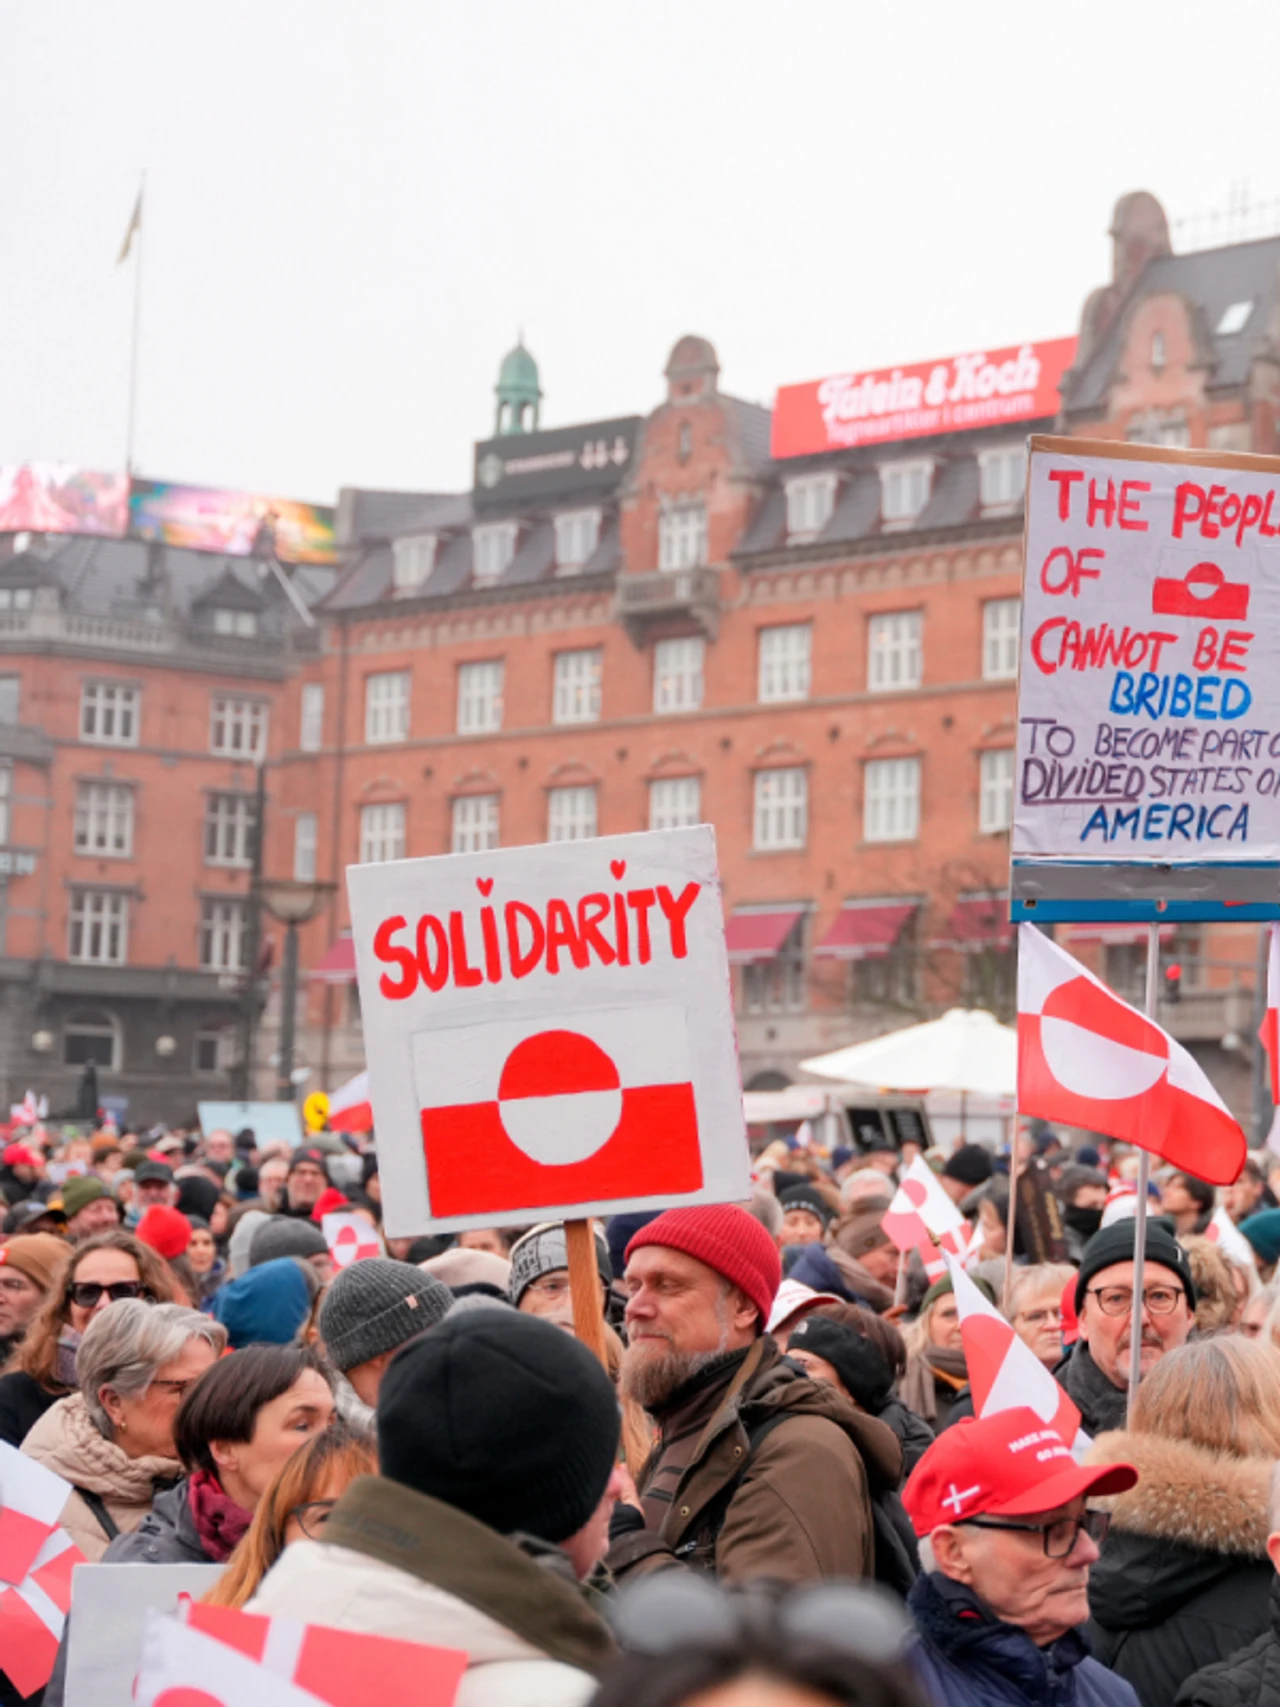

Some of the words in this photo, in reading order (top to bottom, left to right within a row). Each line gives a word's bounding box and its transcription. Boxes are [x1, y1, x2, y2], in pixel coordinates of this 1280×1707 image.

[950, 345, 1039, 401] Koch
[1048, 470, 1151, 531] THE
[1040, 546, 1105, 598] OF
[1030, 616, 1178, 674] CANNOT
[1192, 625, 1255, 672] BE
[1109, 671, 1252, 720] BRIBED
[1020, 717, 1075, 757] TO
[1095, 723, 1198, 760] BECOME
[1199, 727, 1269, 762] PART
[1147, 765, 1252, 798] STATES
[1080, 802, 1250, 842] AMERICA
[1008, 1432, 1041, 1454] MAKE
